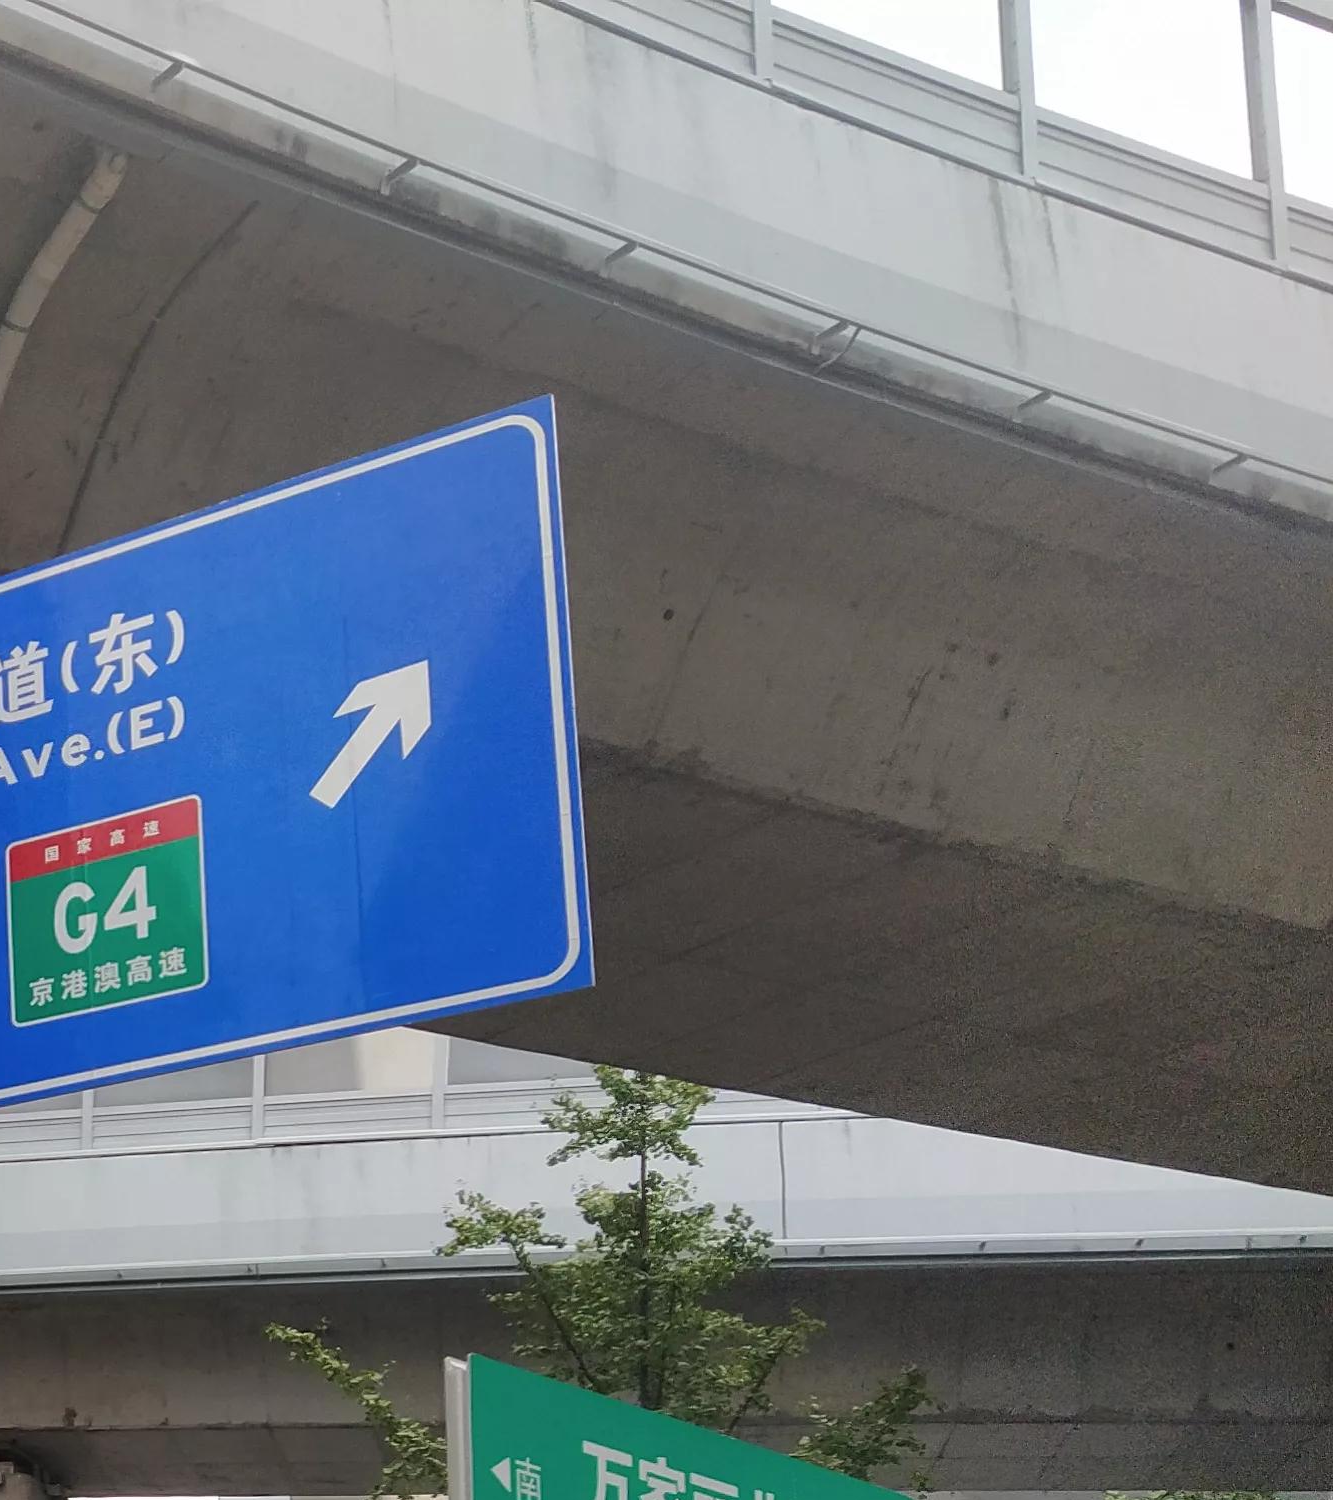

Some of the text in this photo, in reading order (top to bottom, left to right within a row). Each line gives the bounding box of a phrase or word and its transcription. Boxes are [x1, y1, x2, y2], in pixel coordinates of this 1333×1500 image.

[45, 820, 161, 864] 国家高速
[53, 866, 157, 954] G4
[29, 947, 187, 1006] 京港澳高速
